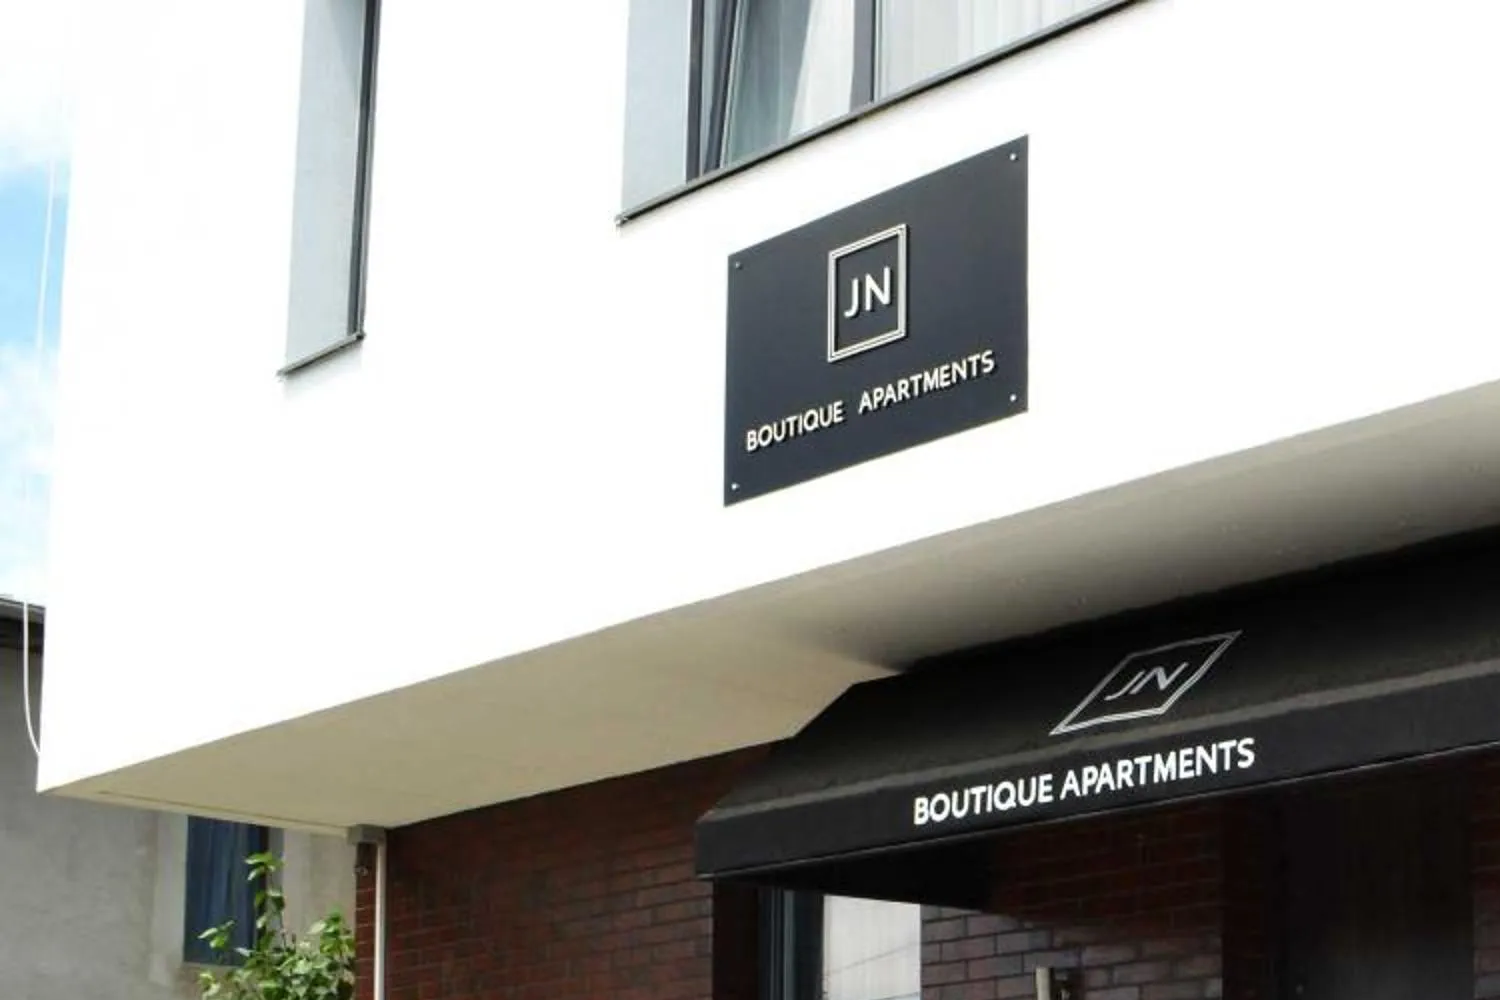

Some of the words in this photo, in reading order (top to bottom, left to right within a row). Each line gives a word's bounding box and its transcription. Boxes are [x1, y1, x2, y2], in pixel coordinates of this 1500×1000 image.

[844, 266, 891, 318] JN
[746, 401, 844, 452] BOUTIQUE
[858, 350, 995, 414] APARTMENTS
[1104, 662, 1190, 701] JN
[914, 773, 1053, 825] BOUTIQUE
[1060, 738, 1255, 801] APARTMENTS
